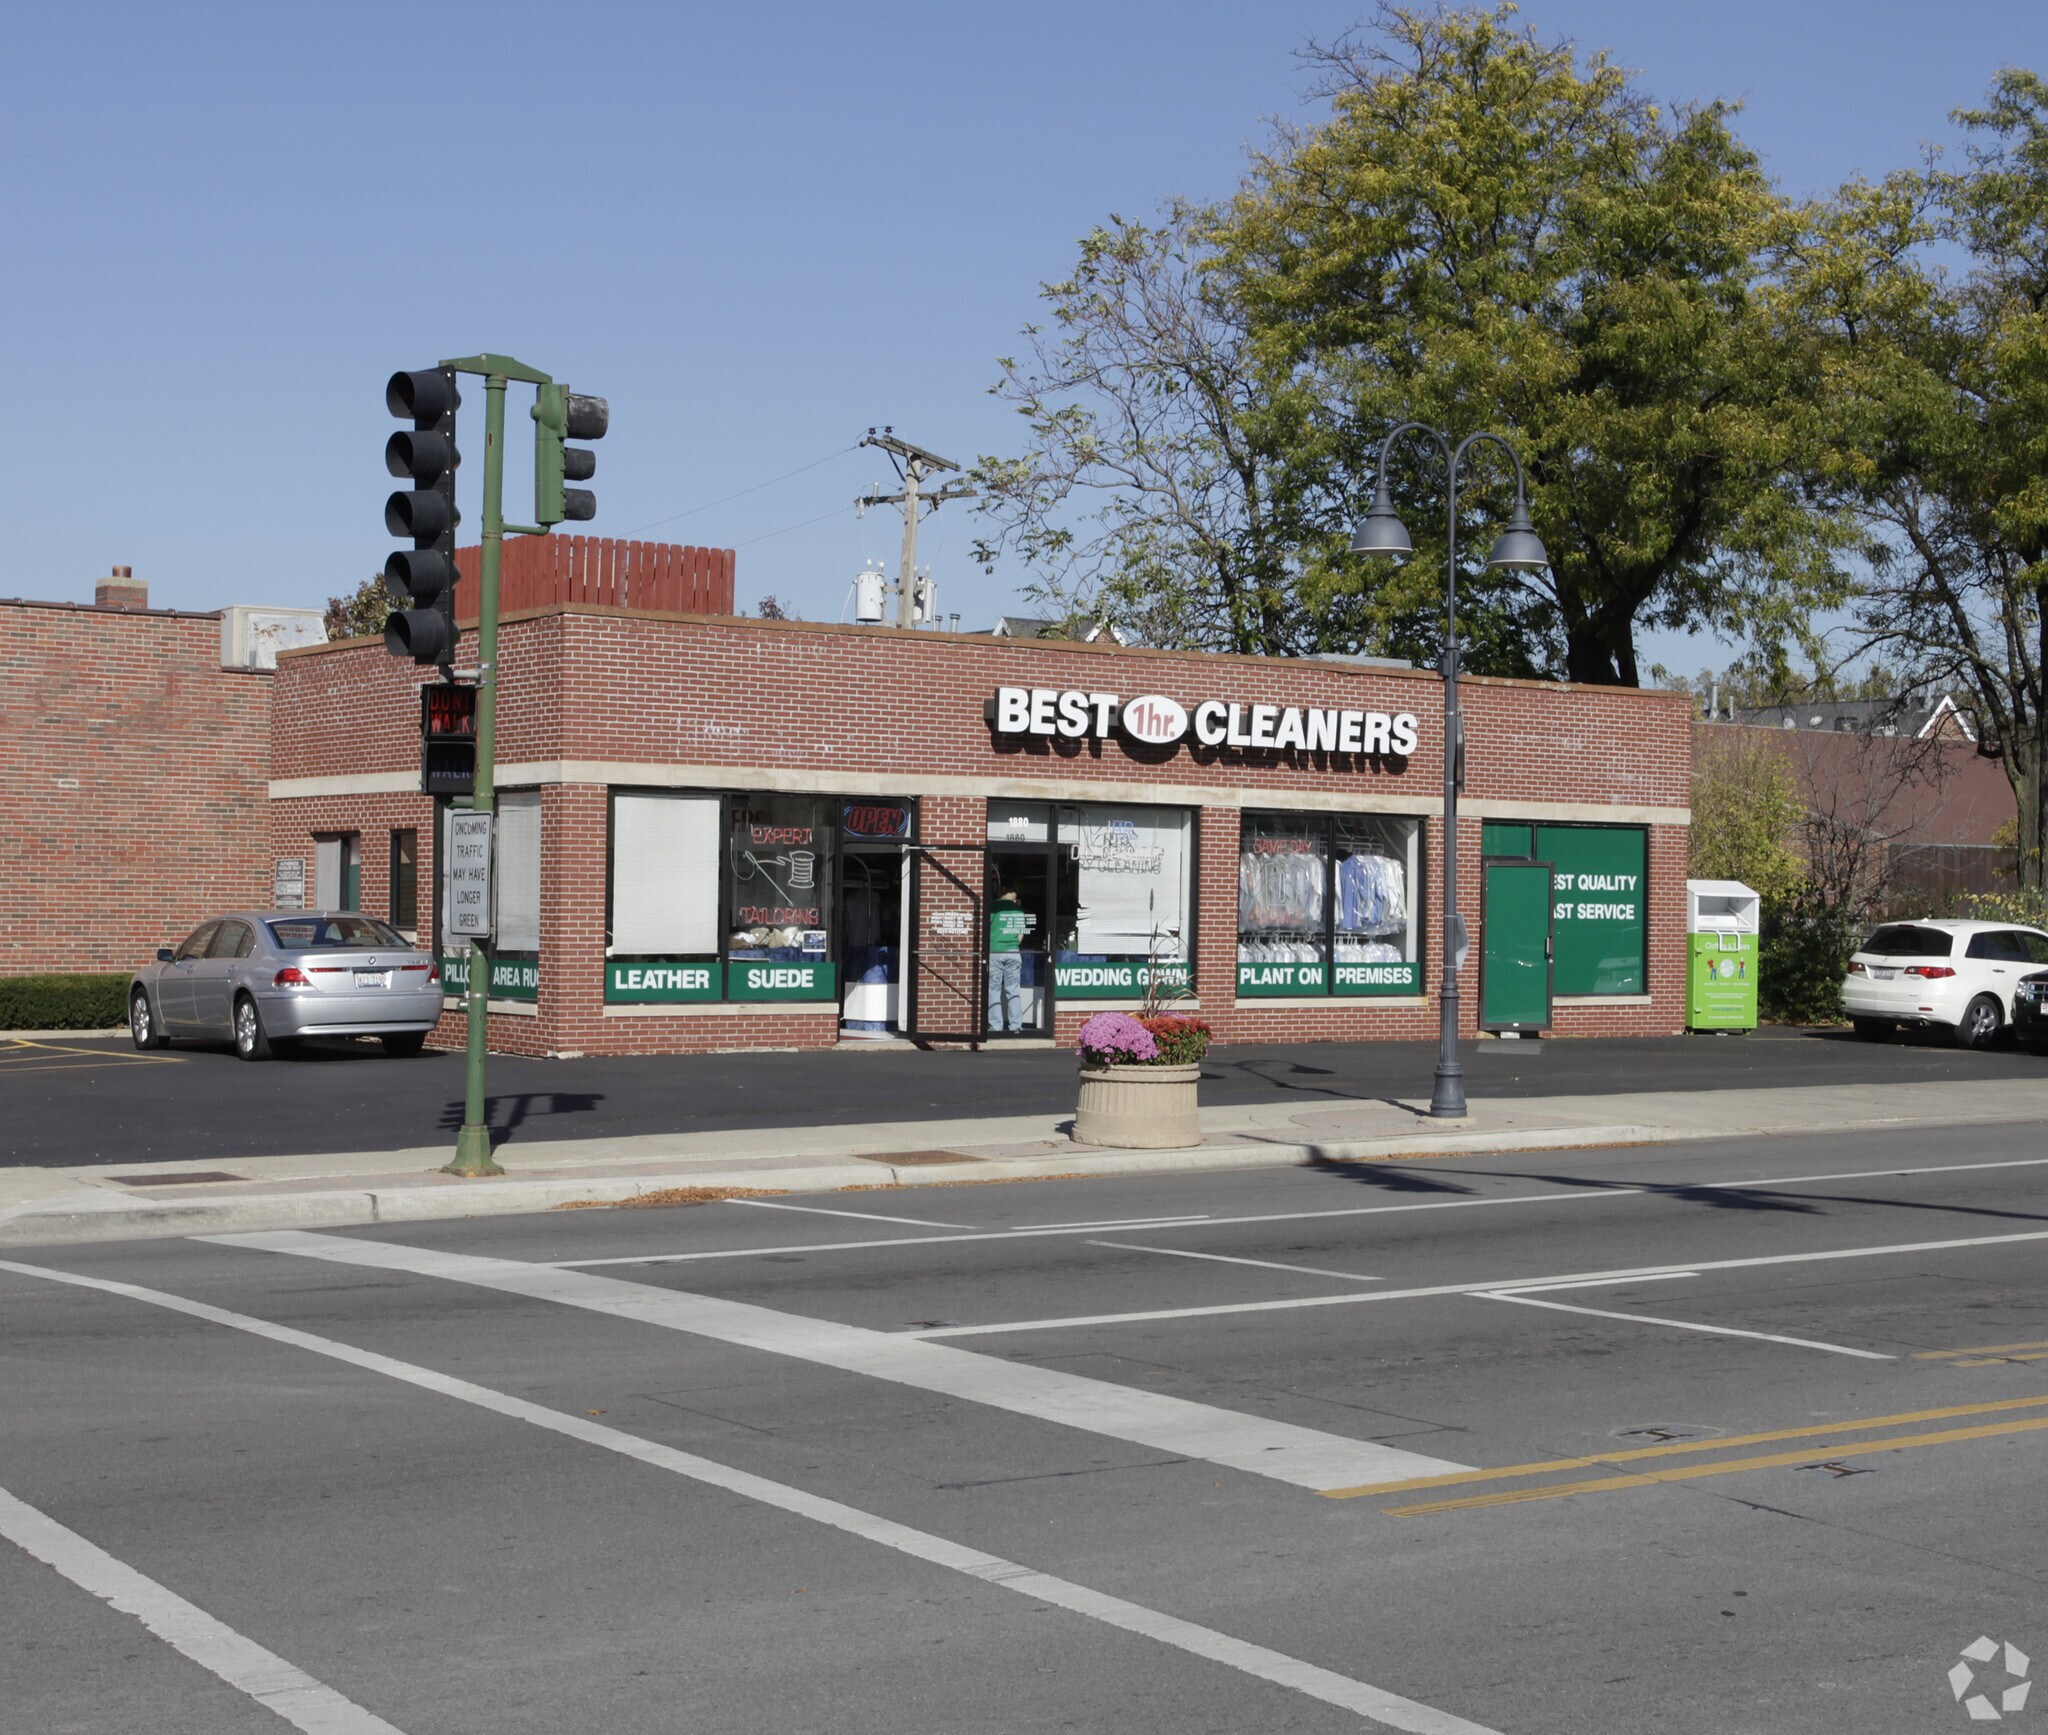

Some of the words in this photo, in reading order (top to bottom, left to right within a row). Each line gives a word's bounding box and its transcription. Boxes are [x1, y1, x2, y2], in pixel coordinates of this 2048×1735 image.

[430, 713, 470, 733] WALK
[998, 687, 1119, 738] BEST
[1133, 703, 1175, 738] 1hr.
[1195, 701, 1418, 755] CLEANERS
[848, 806, 901, 834] OPEN
[1009, 817, 1029, 828] 1880
[455, 822, 487, 836] ONCOMING
[753, 828, 813, 845] EXPERT
[457, 845, 483, 859] TRAFFIC
[453, 868, 466, 881] MAY
[468, 868, 485, 882] HAVE
[1554, 874, 1574, 890] ST
[1578, 874, 1637, 891] QUALITY
[457, 891, 481, 904] LONGER
[739, 906, 819, 925] TAILORING
[1554, 903, 1573, 919] ST
[1577, 903, 1635, 920] SERVICE
[459, 914, 479, 927] GREEN
[493, 966, 520, 986] AREA
[523, 968, 539, 987] RU
[615, 970, 709, 989] LEATHER
[748, 969, 814, 988] SUEDE
[1055, 968, 1131, 986] WEDDING
[1240, 968, 1294, 984] PLANT
[1298, 968, 1322, 984] ON
[1336, 967, 1412, 984] PREMISES
